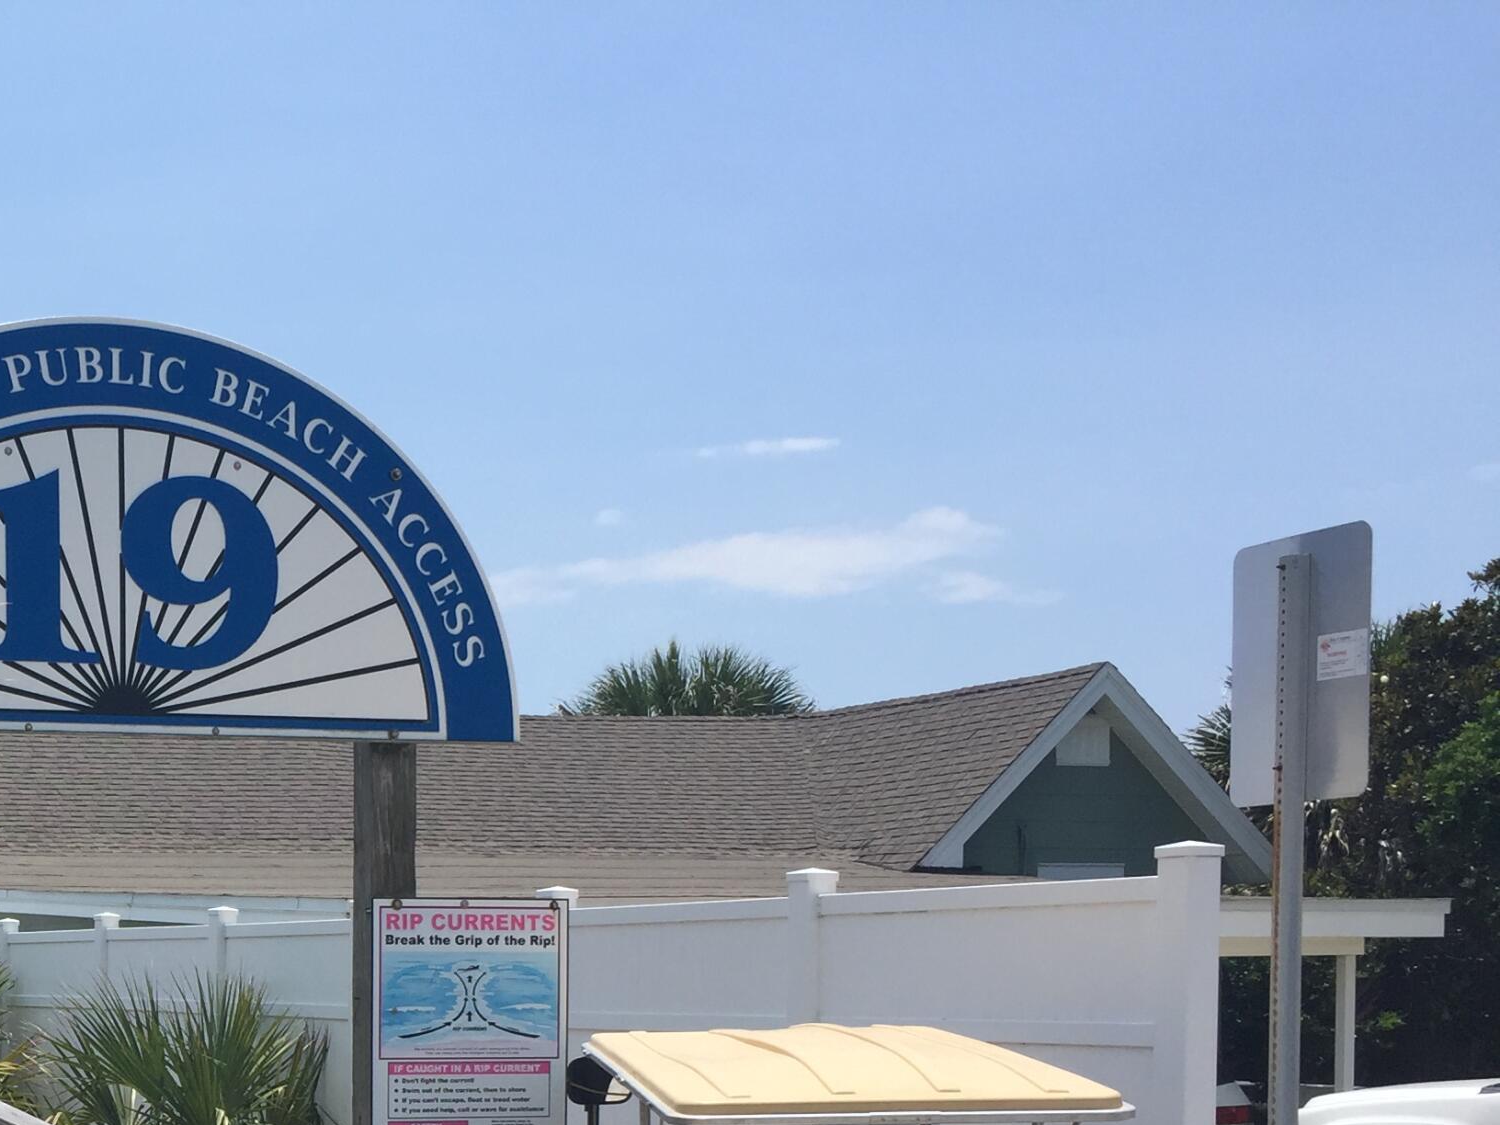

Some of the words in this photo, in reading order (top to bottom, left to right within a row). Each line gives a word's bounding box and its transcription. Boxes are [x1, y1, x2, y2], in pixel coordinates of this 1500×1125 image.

[1, 347, 187, 394] PUBLIC
[208, 368, 368, 482] BEACH
[369, 488, 485, 668] ACCESS
[385, 913, 424, 931] RIP
[430, 913, 556, 932] CURRENTS
[385, 934, 425, 946] Break
[429, 934, 451, 946] the
[454, 935, 483, 948] Grip
[486, 934, 501, 946] of
[504, 935, 526, 946] the
[529, 935, 556, 948] Rip!
[394, 1065, 403, 1073] IF
[406, 1064, 449, 1073] CAUGHT
[450, 1064, 462, 1073] IN
[463, 1064, 472, 1073] A
[473, 1064, 491, 1073] RIP
[493, 1063, 541, 1073] CURRENT
